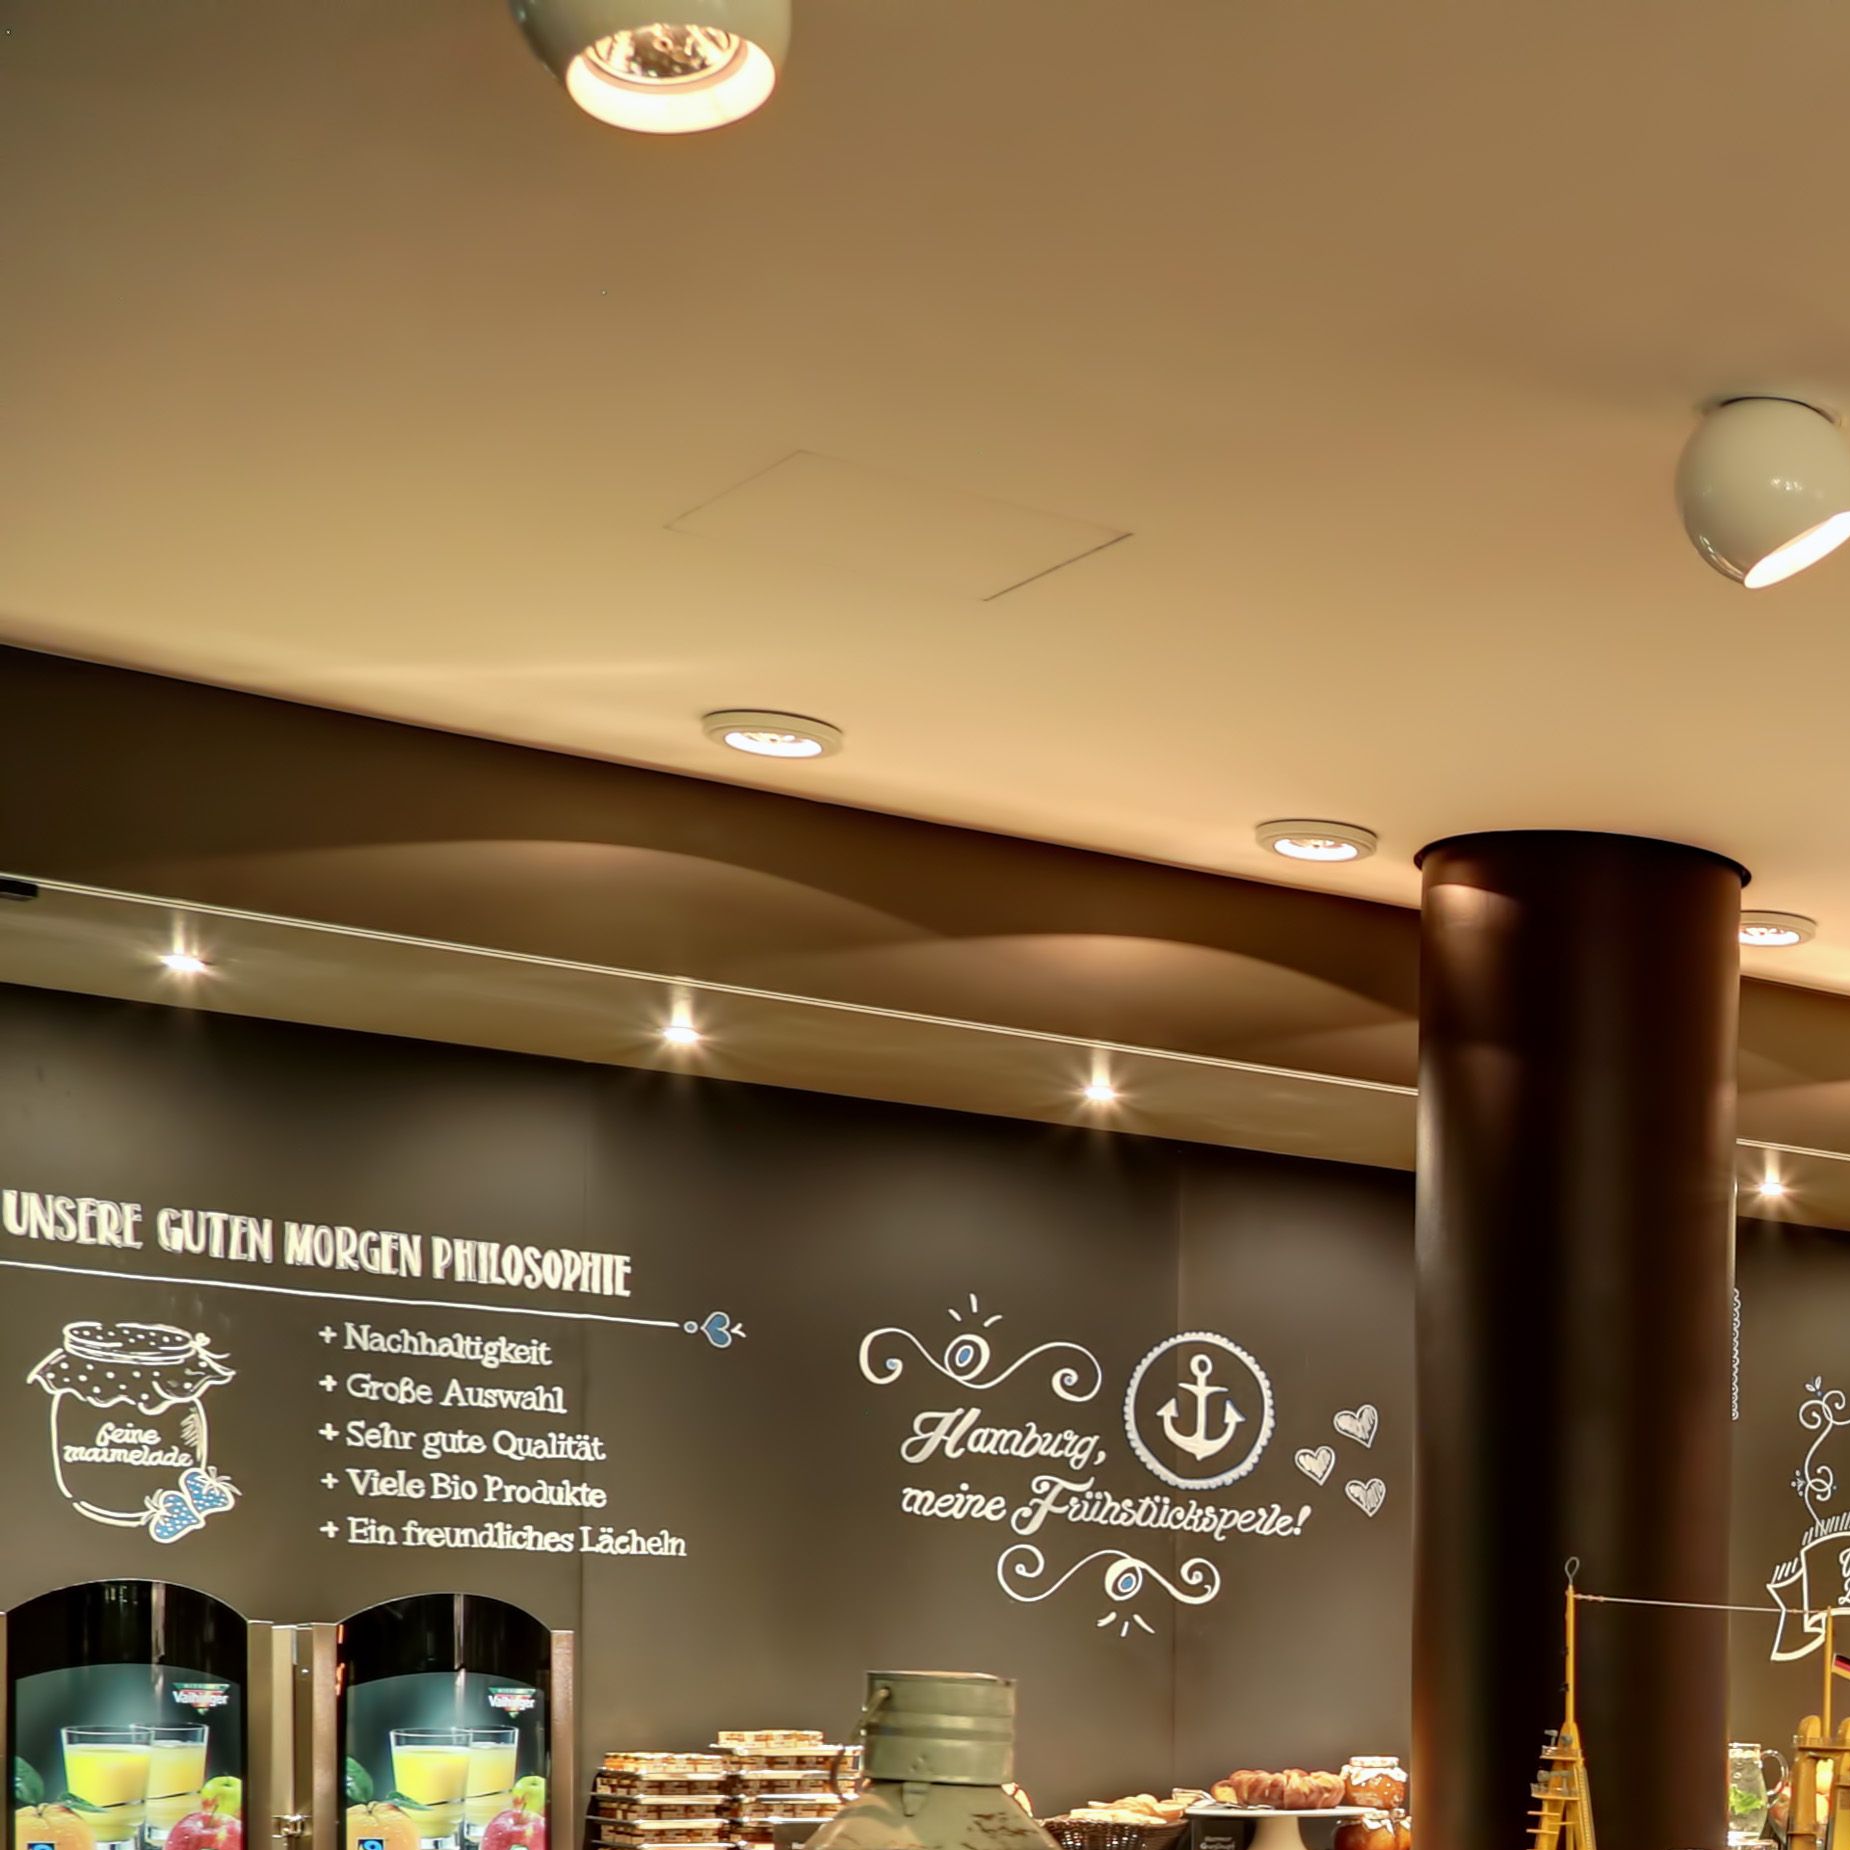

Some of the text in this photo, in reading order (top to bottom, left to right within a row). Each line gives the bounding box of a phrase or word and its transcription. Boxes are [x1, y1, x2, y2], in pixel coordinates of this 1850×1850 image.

[2, 1190, 632, 1298] UNSERE GUTEN MORGEN PHILOSOPHIE
[344, 1323, 553, 1368] Nachhaltigkeit
[346, 1373, 433, 1406] Große
[443, 1379, 566, 1414] Auswahl
[95, 1422, 162, 1446] feine
[345, 1421, 415, 1451] Sehr
[422, 1427, 486, 1459] gute
[493, 1431, 607, 1463] Qualität
[900, 1407, 1107, 1470] Hamburg,
[62, 1445, 194, 1467] marmelade
[345, 1470, 425, 1500] Viele
[432, 1473, 478, 1502] Bio
[486, 1476, 607, 1510] Produkte
[901, 1475, 1312, 1542] meine Frühstücksperle!
[347, 1519, 396, 1547] Ein
[402, 1520, 574, 1554] freundliches
[580, 1527, 688, 1559] Lächeln
